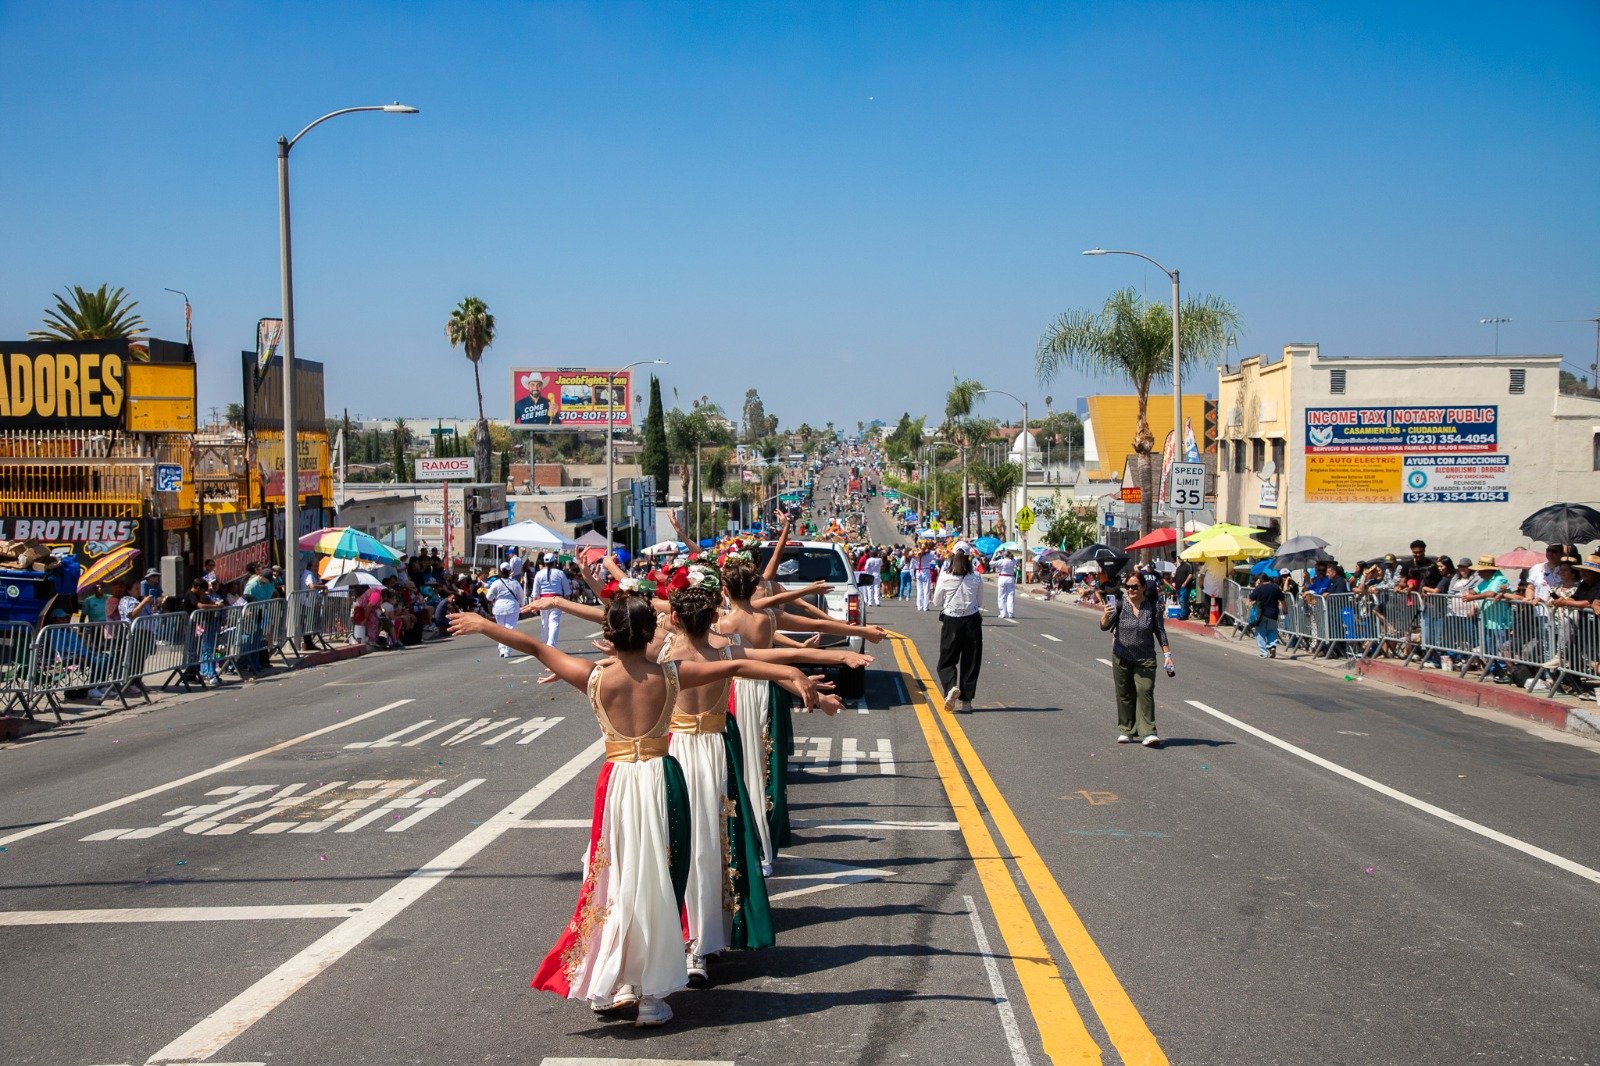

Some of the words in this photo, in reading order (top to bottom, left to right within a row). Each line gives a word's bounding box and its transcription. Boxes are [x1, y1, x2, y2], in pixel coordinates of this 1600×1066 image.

[556, 375, 627, 387] JacobFights.om
[524, 403, 544, 413] COME
[521, 411, 534, 420] SEE
[1308, 410, 1358, 425] INCOME
[1359, 409, 1386, 425] TAX
[1393, 409, 1445, 424] NOTARY
[1447, 408, 1495, 424] PUBLIC
[1344, 427, 1401, 435] CASAMIENTOS
[1408, 426, 1457, 434] CIUDADANIA
[1406, 434, 1436, 445] (323)
[1439, 434, 1495, 443] 354-4054
[422, 460, 469, 470] RAMOS
[1406, 457, 1435, 465] AYUDA
[1436, 457, 1455, 465] CON
[1456, 456, 1507, 465] ADICCIONES
[1174, 467, 1204, 475] SPEED
[1176, 478, 1199, 486] LIMIT
[1175, 489, 1200, 505] 35
[1406, 492, 1439, 501] (323)
[1443, 492, 1505, 501] 354-4054
[14, 519, 132, 541] BROTHERS
[213, 516, 267, 557] MOFLES
[343, 716, 566, 749] WAIT
[78, 778, 487, 842] HERE
